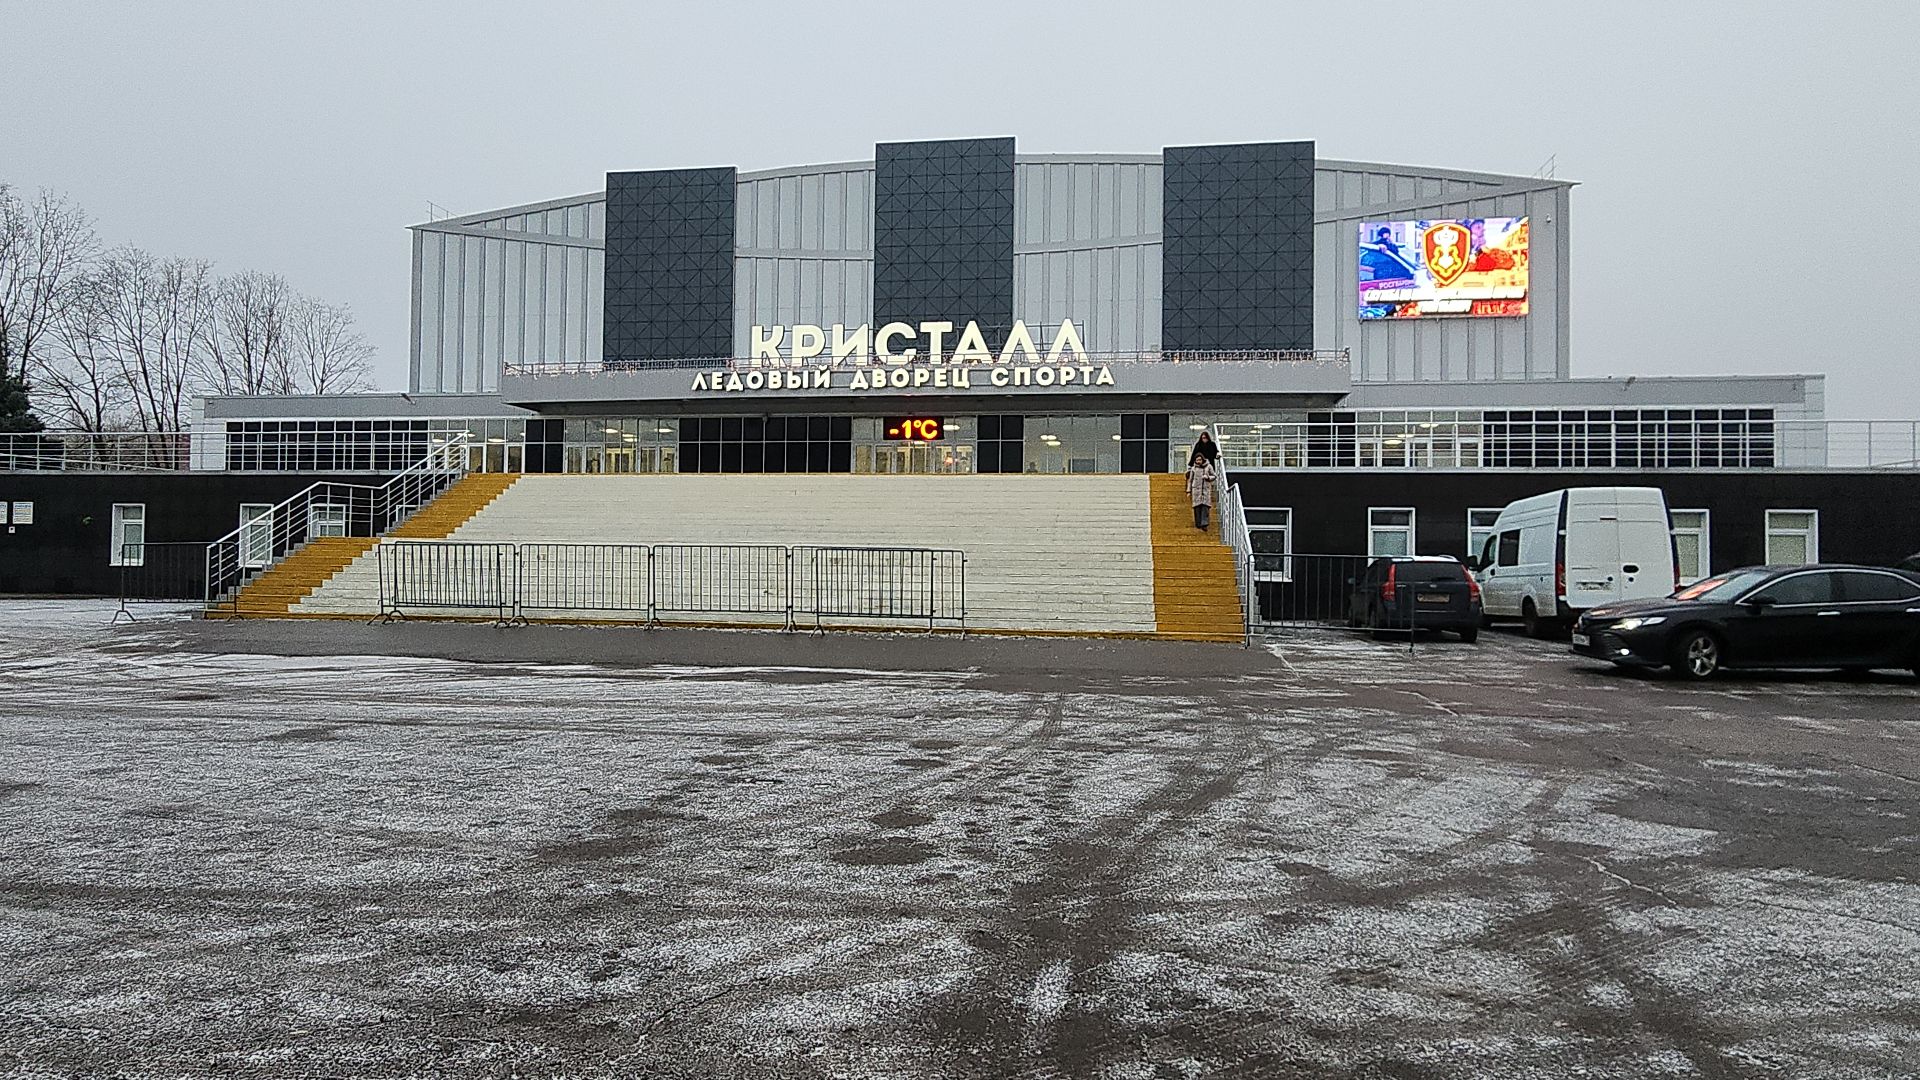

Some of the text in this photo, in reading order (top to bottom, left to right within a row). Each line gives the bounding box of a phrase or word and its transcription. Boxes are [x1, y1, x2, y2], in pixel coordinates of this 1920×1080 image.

[751, 318, 1090, 368] КРИСТАЛЛ
[691, 365, 1115, 391] ЛЕДОВЫЙ ДВОРЕЦ СПОРТА
